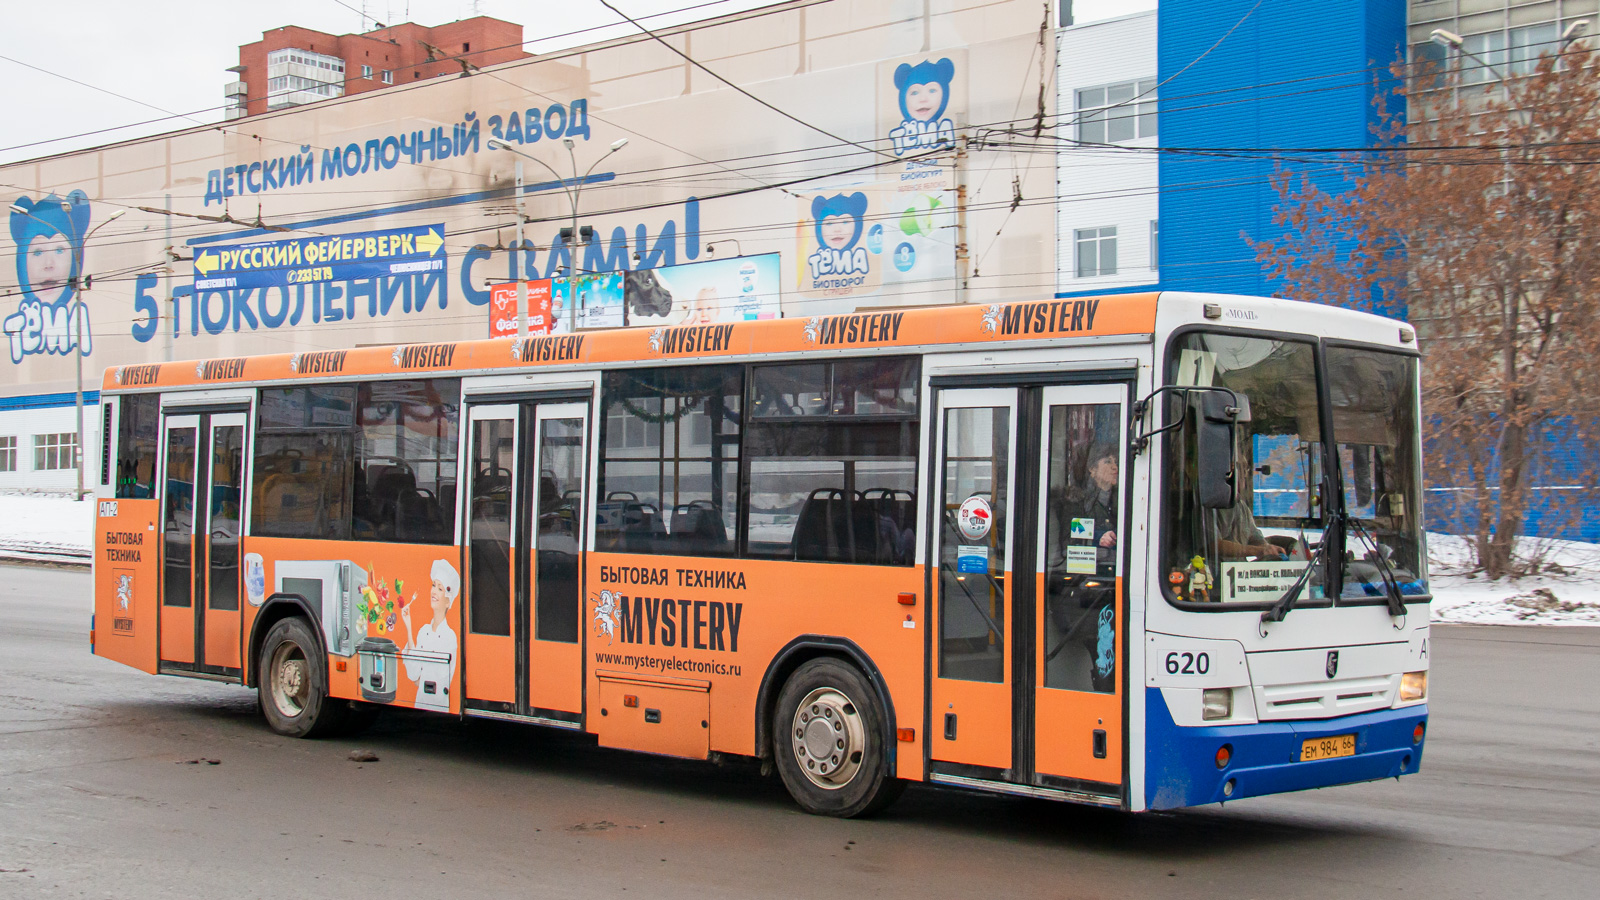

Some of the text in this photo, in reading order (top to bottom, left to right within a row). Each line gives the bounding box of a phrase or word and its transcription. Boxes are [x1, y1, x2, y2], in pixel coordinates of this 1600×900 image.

[204, 98, 590, 207] ДЕТСКИЙ МОЛОЧНЫЙ ЗАВОД
[221, 234, 414, 270] РУССКИЙ ФЕЙЕРВЕРК
[901, 246, 910, 262] 8
[296, 268, 312, 282] 233
[813, 276, 865, 289] БИОТВОРОГ
[132, 273, 158, 343] 5
[460, 244, 490, 306] С
[496, 314, 544, 332] Фабика
[819, 312, 904, 345] MYSTERY
[1000, 300, 1100, 336] MYSTERY
[522, 335, 585, 363] MYSTERY
[662, 324, 734, 354] MYSTERY
[299, 351, 348, 374] MYSTERY
[401, 344, 455, 368] MYSTERY
[121, 365, 161, 385] MYSTERY
[203, 360, 246, 380] MYSTERY
[100, 502, 118, 516] АП-2
[106, 532, 143, 545] БЫТОВАЯ
[106, 549, 141, 562] ТЕХНИКА
[601, 566, 746, 589] БЫТОВАЯ ТЕХНИКА
[1227, 567, 1235, 598] 1
[114, 618, 133, 630] MYSTERY
[620, 596, 743, 652] MYSTERY
[596, 653, 741, 676] www.mysteryelectronics.ru
[1165, 652, 1210, 674] 620
[1320, 740, 1338, 756] 984
[1342, 737, 1352, 749] 66
